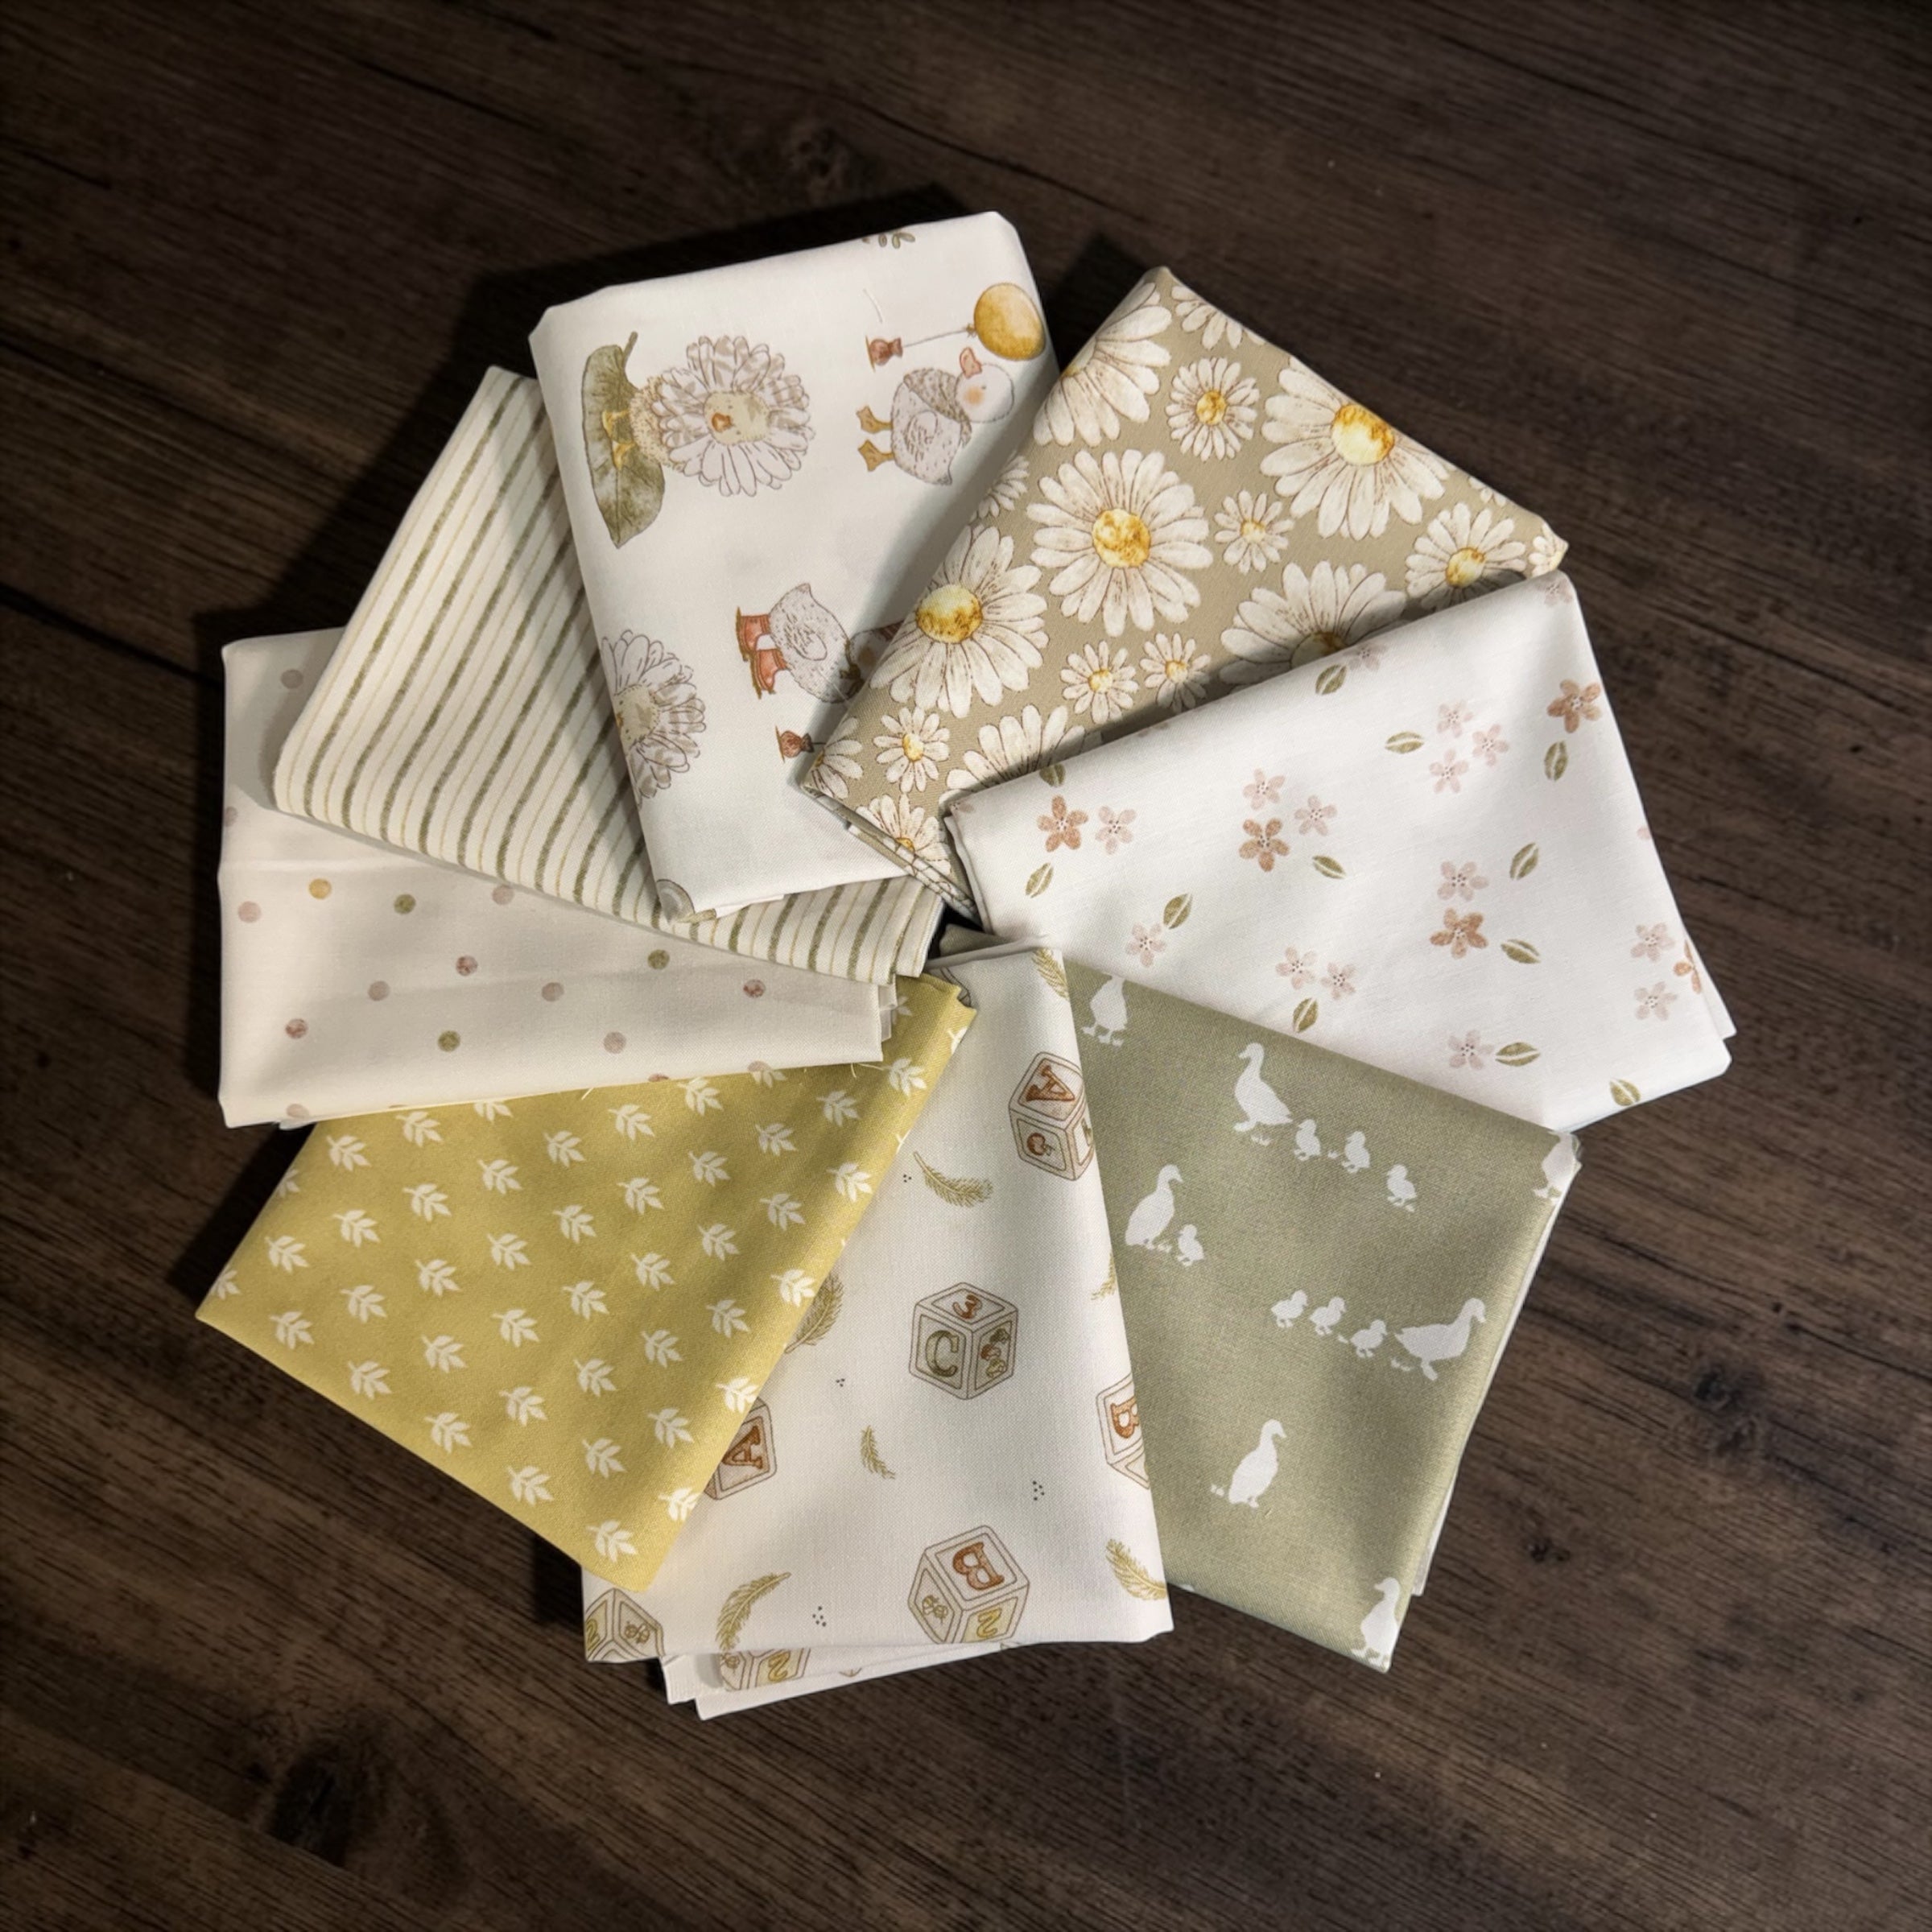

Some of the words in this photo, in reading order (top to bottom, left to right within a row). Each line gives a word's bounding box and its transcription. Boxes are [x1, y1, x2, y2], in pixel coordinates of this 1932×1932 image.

[1026, 1065, 1075, 1101] A
[925, 1330, 960, 1377] C
[720, 1426, 763, 1470] A
[952, 1542, 1005, 1591] B
